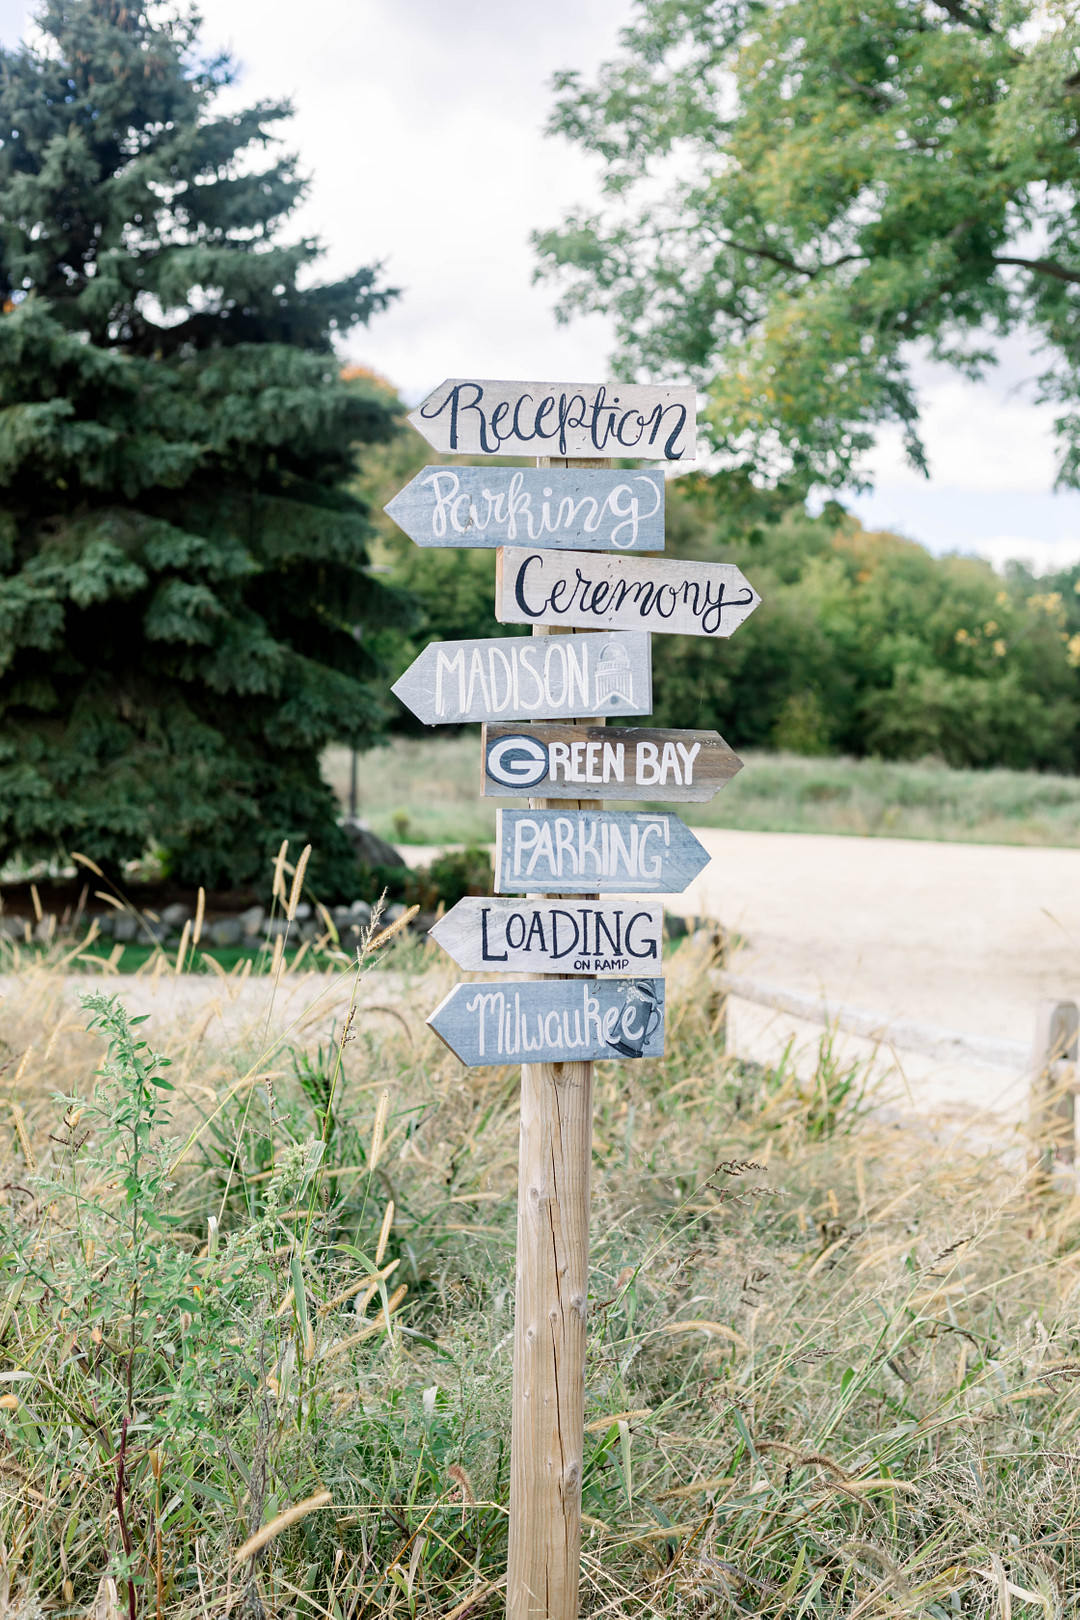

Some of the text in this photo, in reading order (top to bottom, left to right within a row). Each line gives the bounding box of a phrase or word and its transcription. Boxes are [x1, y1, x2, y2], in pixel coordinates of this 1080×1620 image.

[420, 383, 687, 459] Reception
[421, 471, 661, 549] Parking
[515, 554, 754, 633] Ceremony
[434, 642, 589, 717] MADISON
[486, 735, 701, 788] GREEN BAY
[513, 817, 663, 878] PARKING
[481, 908, 658, 961] LOADING
[573, 959, 630, 971] ON RAMP
[466, 983, 645, 1057] Milwaukee
